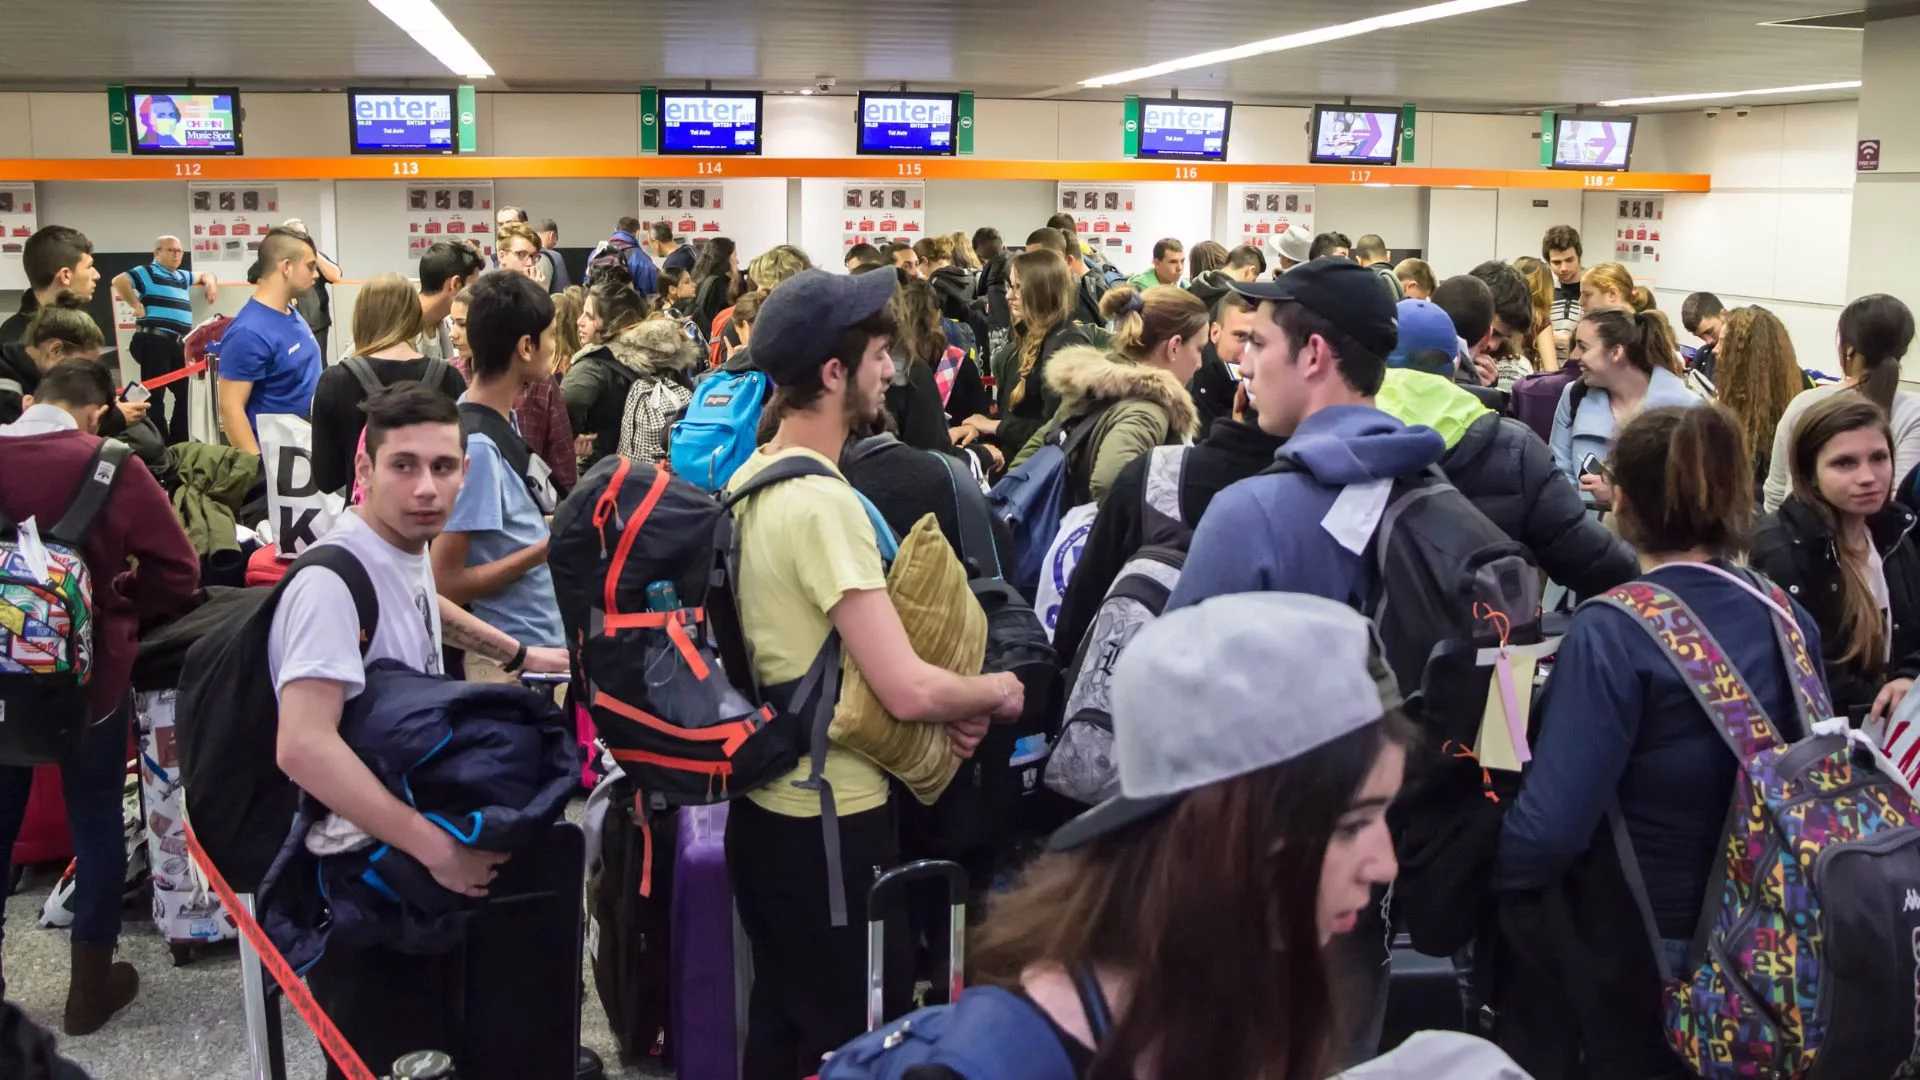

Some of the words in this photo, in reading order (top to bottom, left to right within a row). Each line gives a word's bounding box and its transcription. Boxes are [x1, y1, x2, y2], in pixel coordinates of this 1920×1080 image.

[356, 97, 437, 119] enter
[666, 99, 743, 121] enter
[865, 100, 940, 121] enter
[1145, 107, 1214, 128] enter
[187, 131, 211, 140] Music
[212, 131, 232, 141] Spot
[175, 163, 202, 176] 112
[393, 162, 419, 175] 113
[698, 162, 722, 174] 114
[898, 163, 922, 175] 115
[1175, 167, 1197, 179] 116
[1350, 170, 1371, 182] 117
[1584, 175, 1603, 186] 118
[277, 445, 319, 497] D
[279, 505, 321, 554] K
